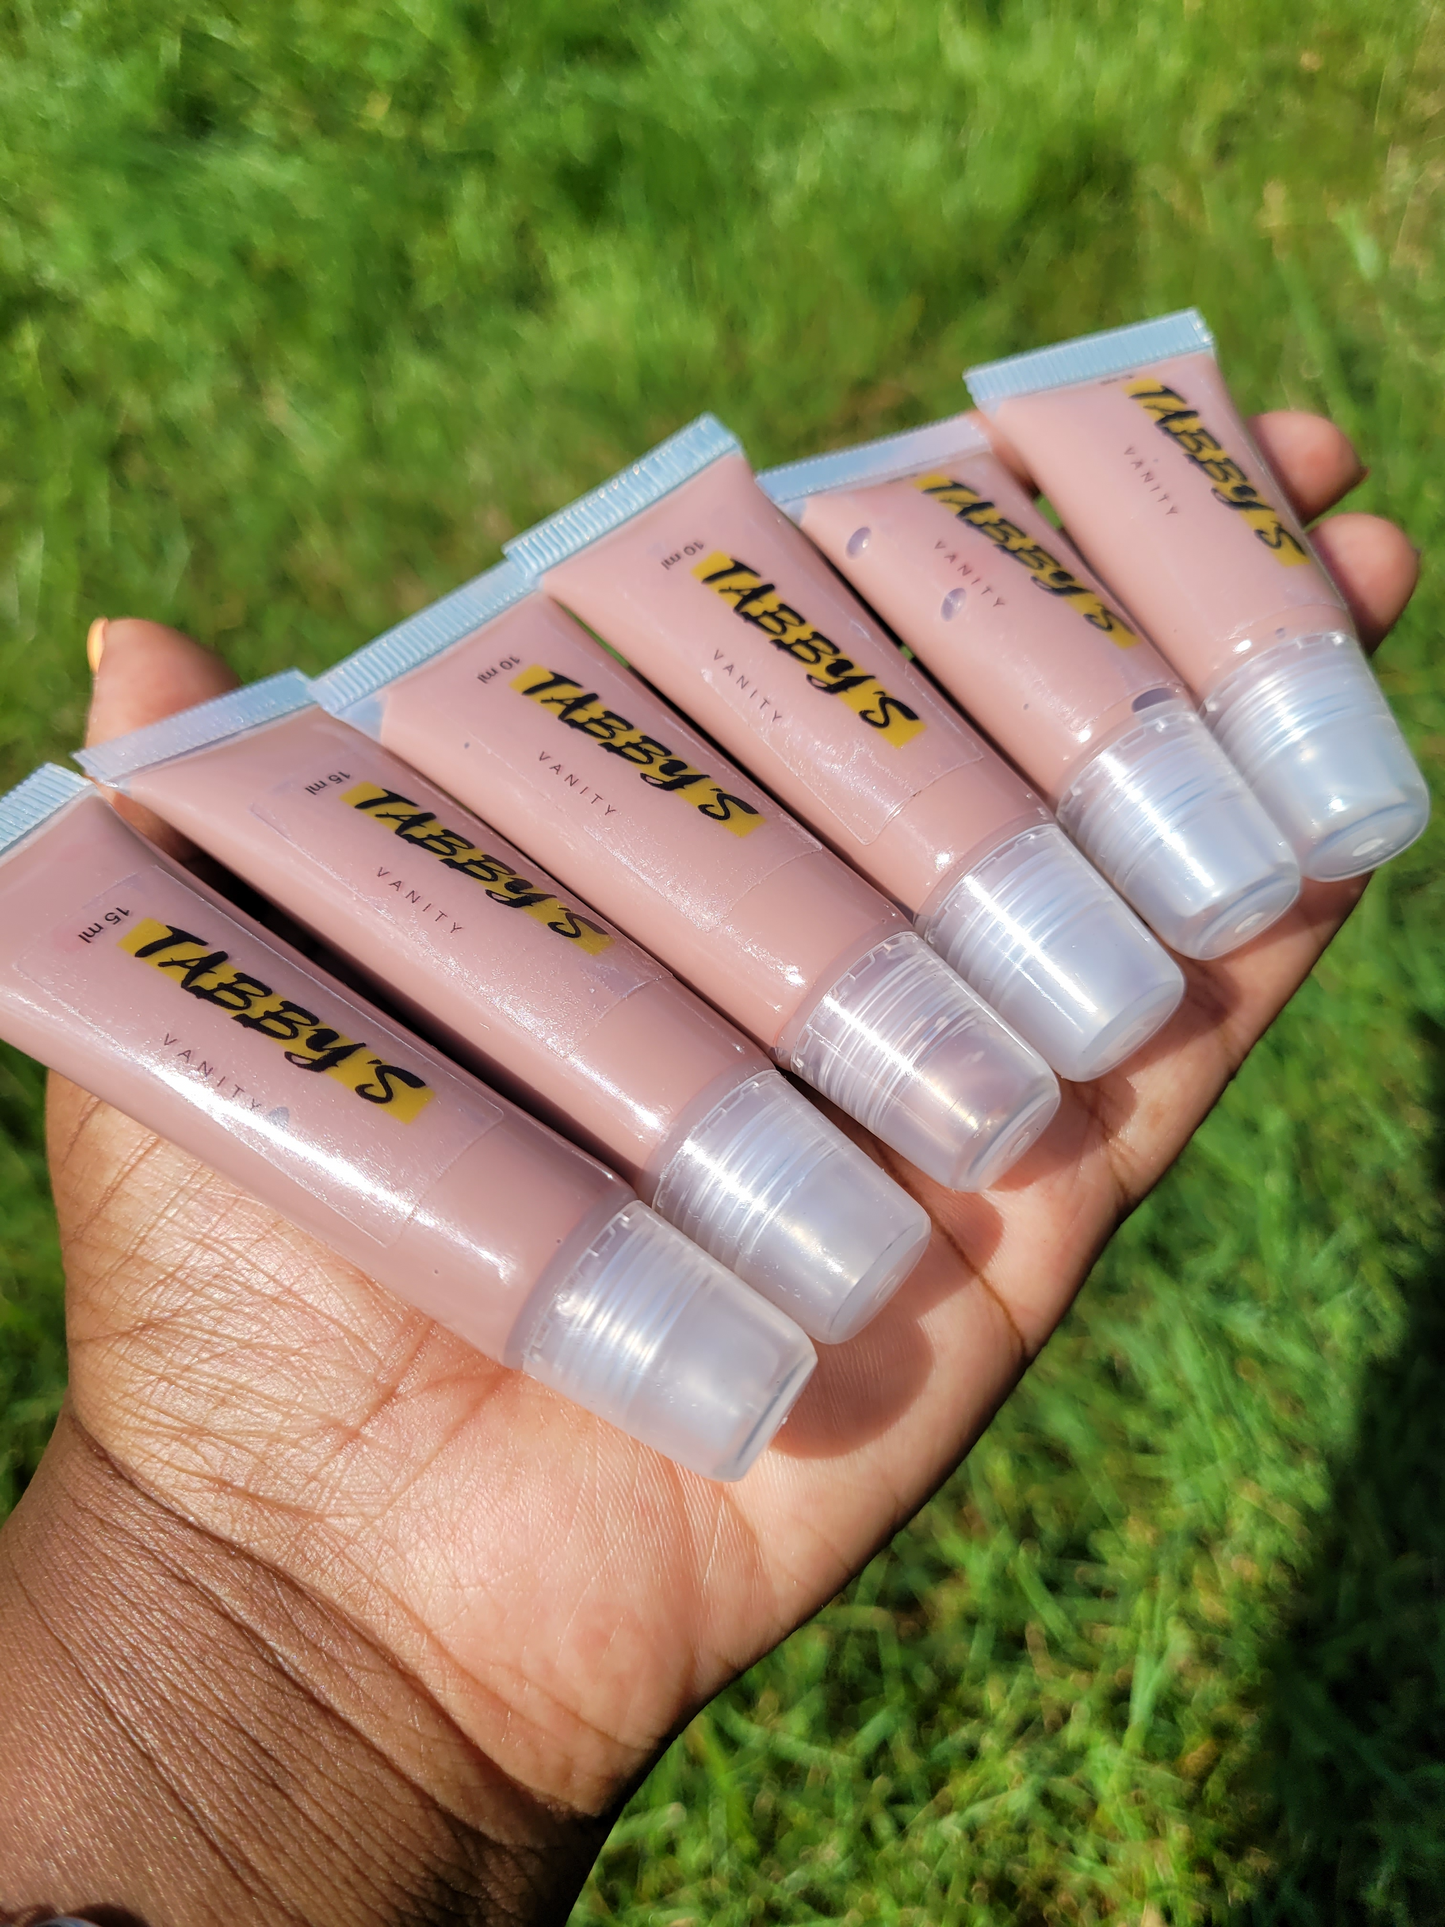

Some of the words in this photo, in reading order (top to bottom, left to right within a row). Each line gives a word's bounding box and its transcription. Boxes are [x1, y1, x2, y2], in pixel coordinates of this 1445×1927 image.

[1123, 445, 1179, 515] VANITY
[683, 541, 704, 556] 10
[934, 540, 1006, 608] VANITY
[499, 656, 520, 670] 10
[477, 667, 498, 684] ml
[712, 649, 783, 723] VANITY
[305, 780, 328, 795] ml
[328, 771, 351, 784] 15
[538, 751, 617, 817] VANITY
[376, 866, 463, 935] VANITY
[104, 907, 130, 925] 15
[78, 923, 104, 944] ml
[163, 1032, 262, 1112] VANITY
